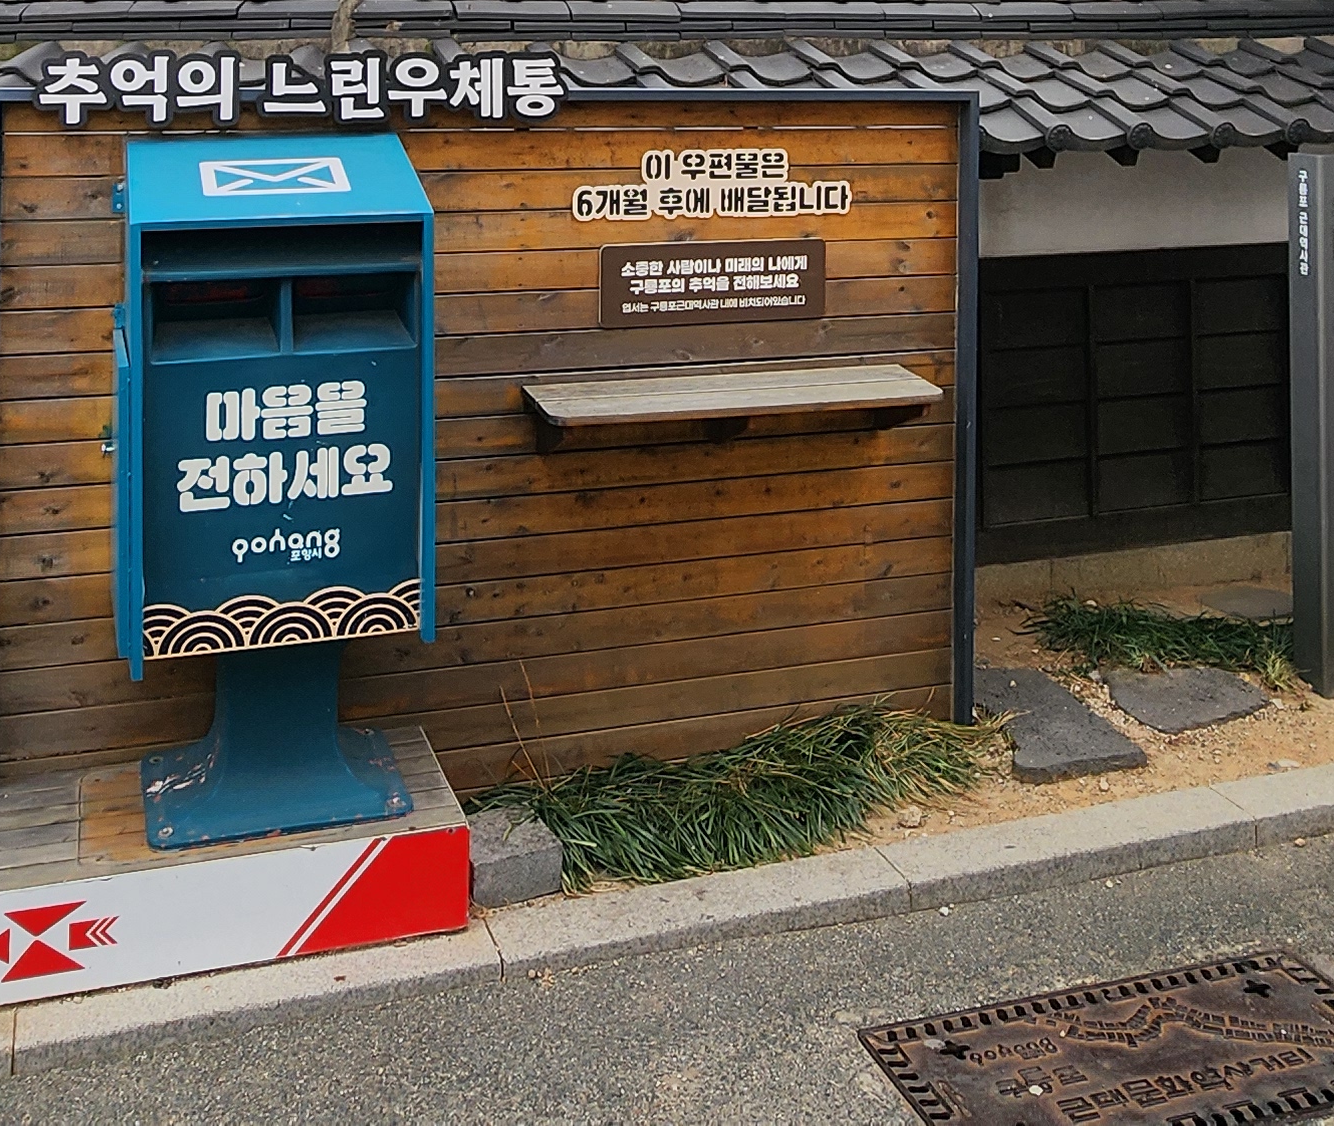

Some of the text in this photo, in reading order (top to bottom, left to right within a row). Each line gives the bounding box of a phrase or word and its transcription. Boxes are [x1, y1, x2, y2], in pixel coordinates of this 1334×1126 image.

[39, 55, 236, 126] 추억의
[645, 152, 785, 181] 이 우편물은
[576, 184, 849, 217] 6개월 후에 배달됩니다
[621, 254, 808, 277] 소중한 사람이나 미래의 나에게
[629, 273, 799, 295] 구룡포의 추억을 전해보세요
[205, 380, 368, 442] 마음을
[176, 442, 393, 513] 전하세요
